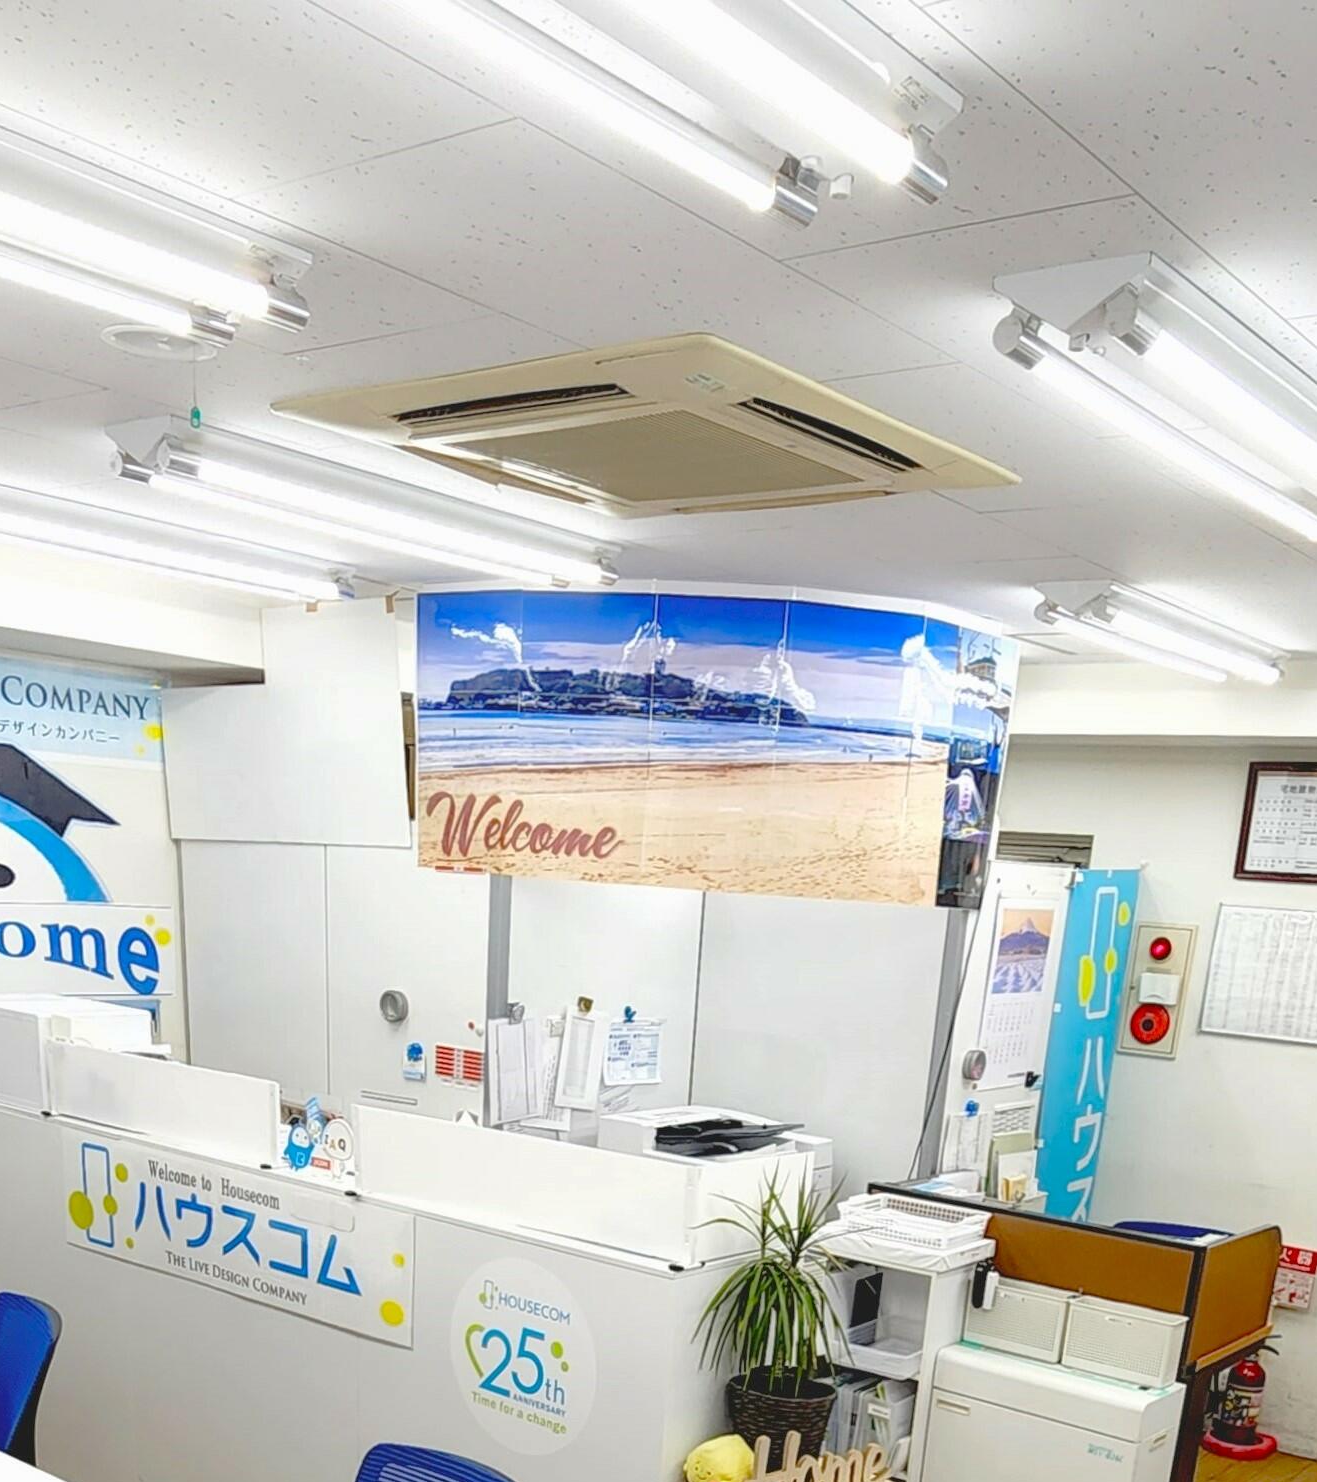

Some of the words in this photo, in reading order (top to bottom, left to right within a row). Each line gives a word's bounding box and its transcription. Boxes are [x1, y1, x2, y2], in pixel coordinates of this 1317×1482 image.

[0, 674, 150, 721] COMPANY
[426, 791, 624, 859] Welcome
[148, 1160, 198, 1190] Welcome
[200, 1174, 213, 1191] to
[220, 1178, 281, 1210] Housecom
[134, 1181, 362, 1297] ハウスコム
[165, 1250, 186, 1268] THE
[188, 1256, 211, 1275] LIVE
[212, 1262, 250, 1289] DESIGN
[252, 1275, 308, 1306] COMPANY
[498, 1290, 571, 1326] HOUSECOM
[471, 1390, 496, 1411] Time
[497, 1400, 514, 1417] for
[526, 1410, 568, 1435] change
[512, 1392, 567, 1418] ANNIVERSARY
